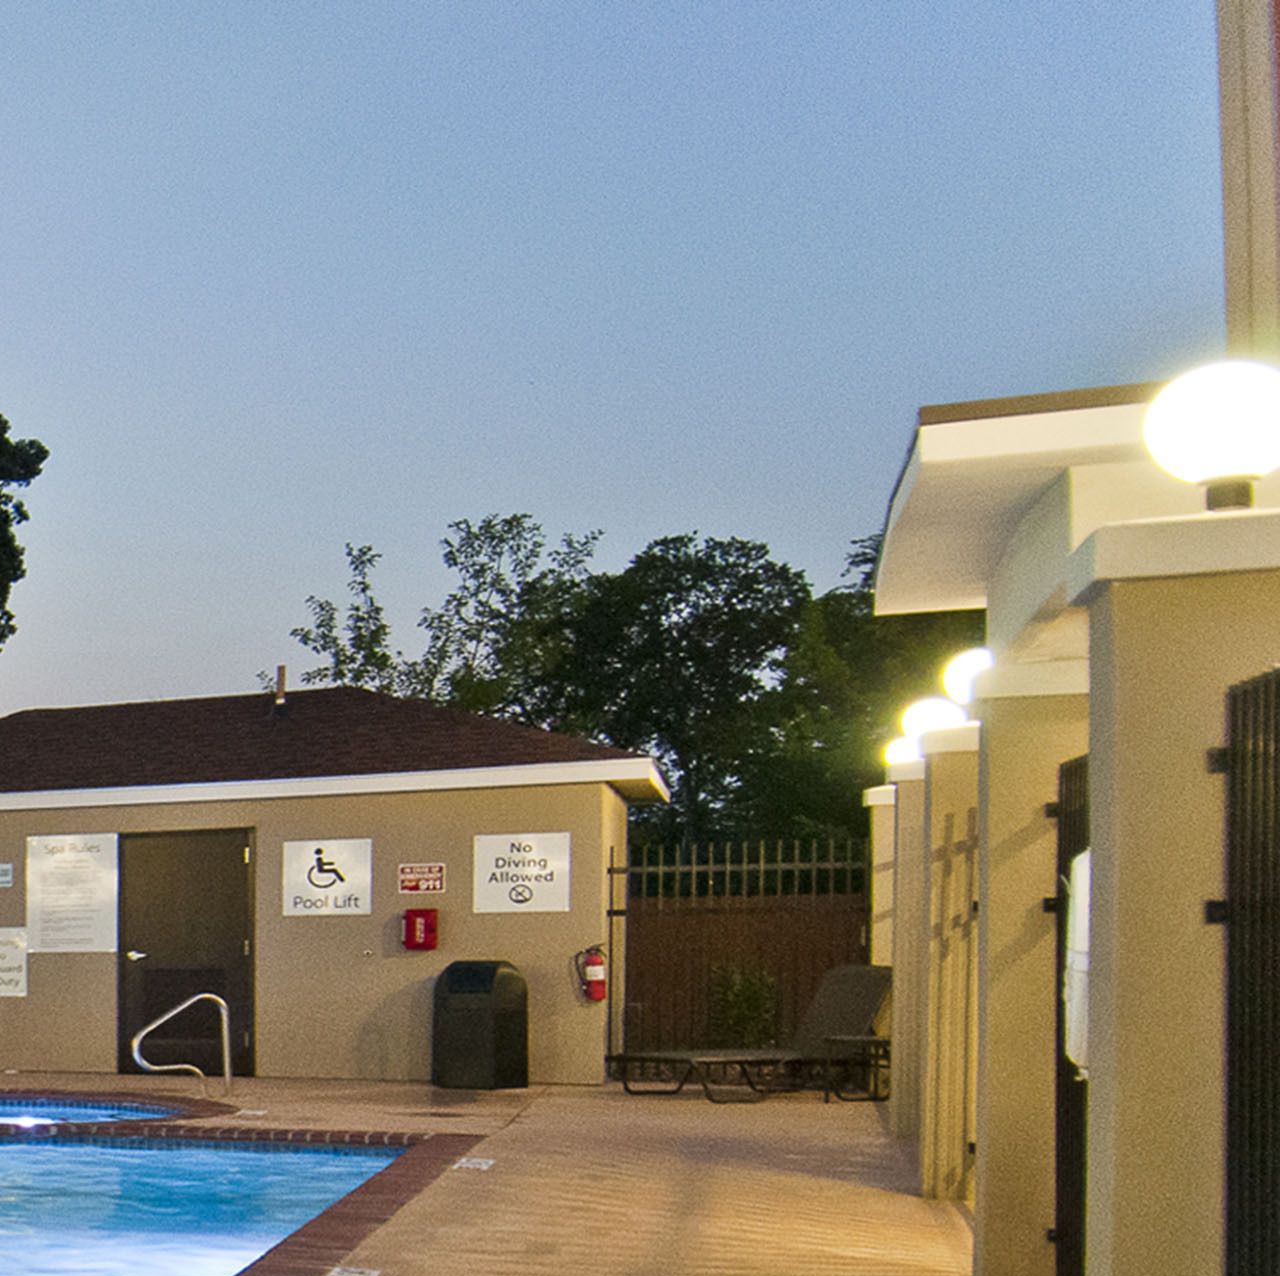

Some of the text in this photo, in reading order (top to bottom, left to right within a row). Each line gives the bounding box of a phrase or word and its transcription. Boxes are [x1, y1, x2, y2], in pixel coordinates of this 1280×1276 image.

[44, 843, 101, 856] Spa Rules
[509, 842, 533, 853] No
[495, 857, 548, 869] Diving
[488, 871, 555, 883] Allowed
[293, 894, 360, 909] Pool Lift
